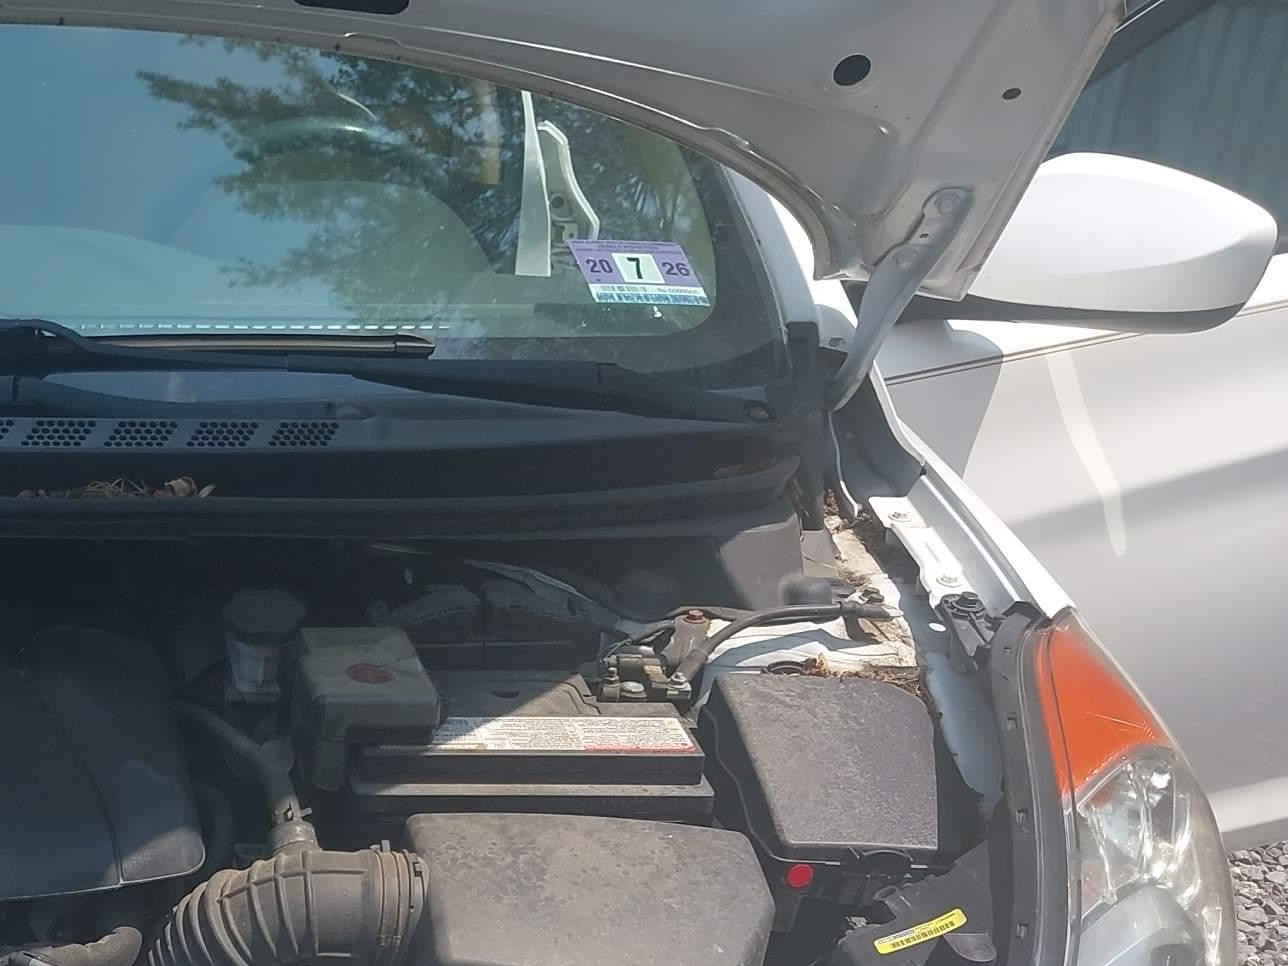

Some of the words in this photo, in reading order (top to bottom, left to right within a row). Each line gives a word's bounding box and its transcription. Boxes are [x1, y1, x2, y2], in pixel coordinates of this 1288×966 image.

[586, 258, 613, 274] 20
[626, 257, 644, 280] 7
[661, 261, 690, 276] 26
